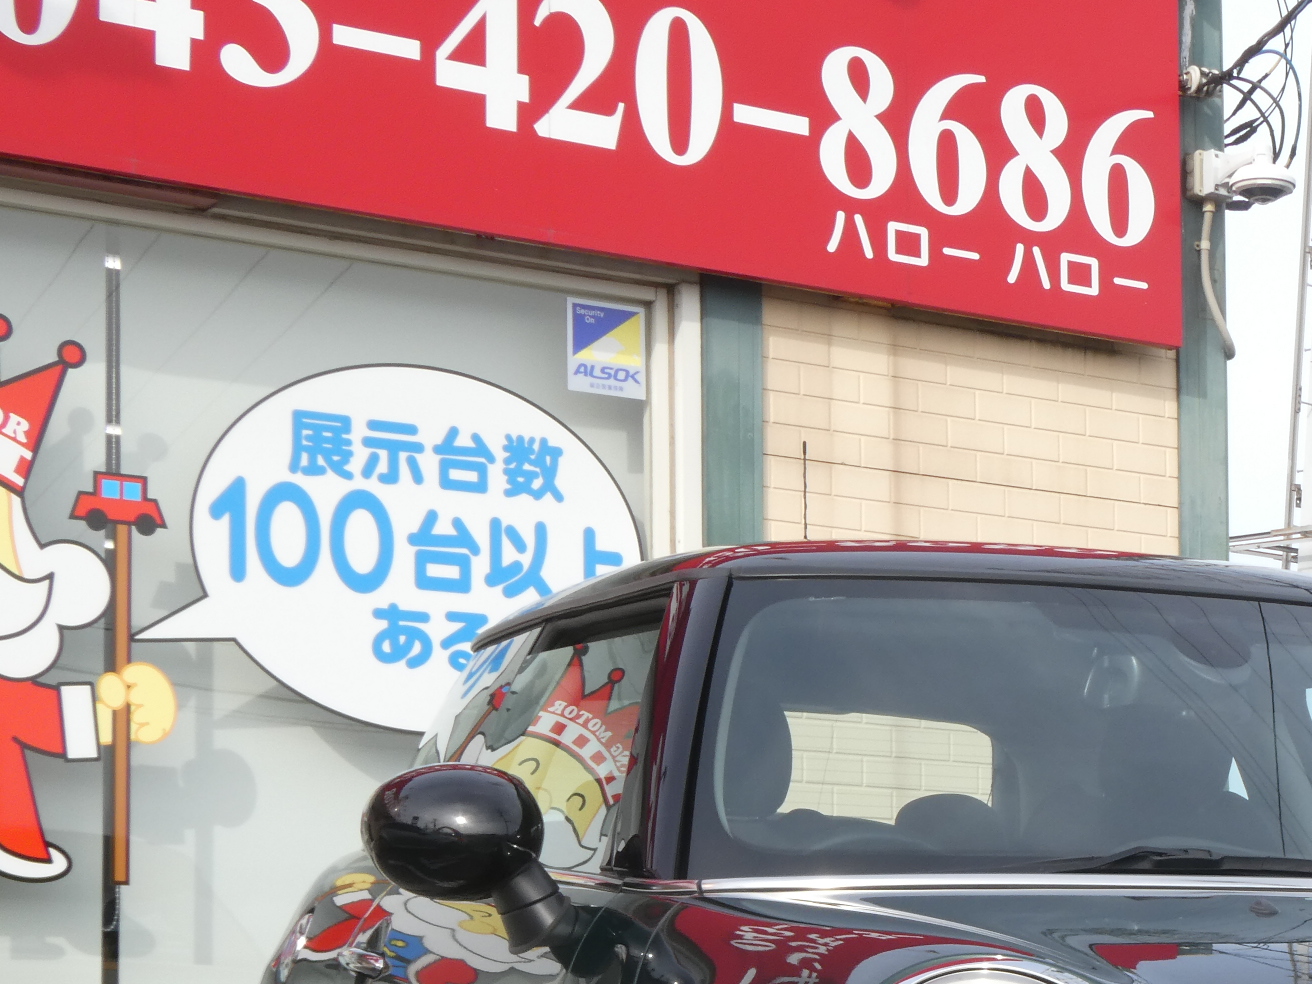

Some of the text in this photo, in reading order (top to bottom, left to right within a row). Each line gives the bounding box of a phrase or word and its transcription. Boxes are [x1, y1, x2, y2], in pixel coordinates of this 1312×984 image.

[826, 210, 1149, 296] ハロー ハロー
[576, 306, 604, 318] Security
[584, 315, 595, 324] On
[573, 362, 641, 385] ALSOK
[288, 409, 564, 503] 展示台数
[208, 475, 624, 600] 100台以上
